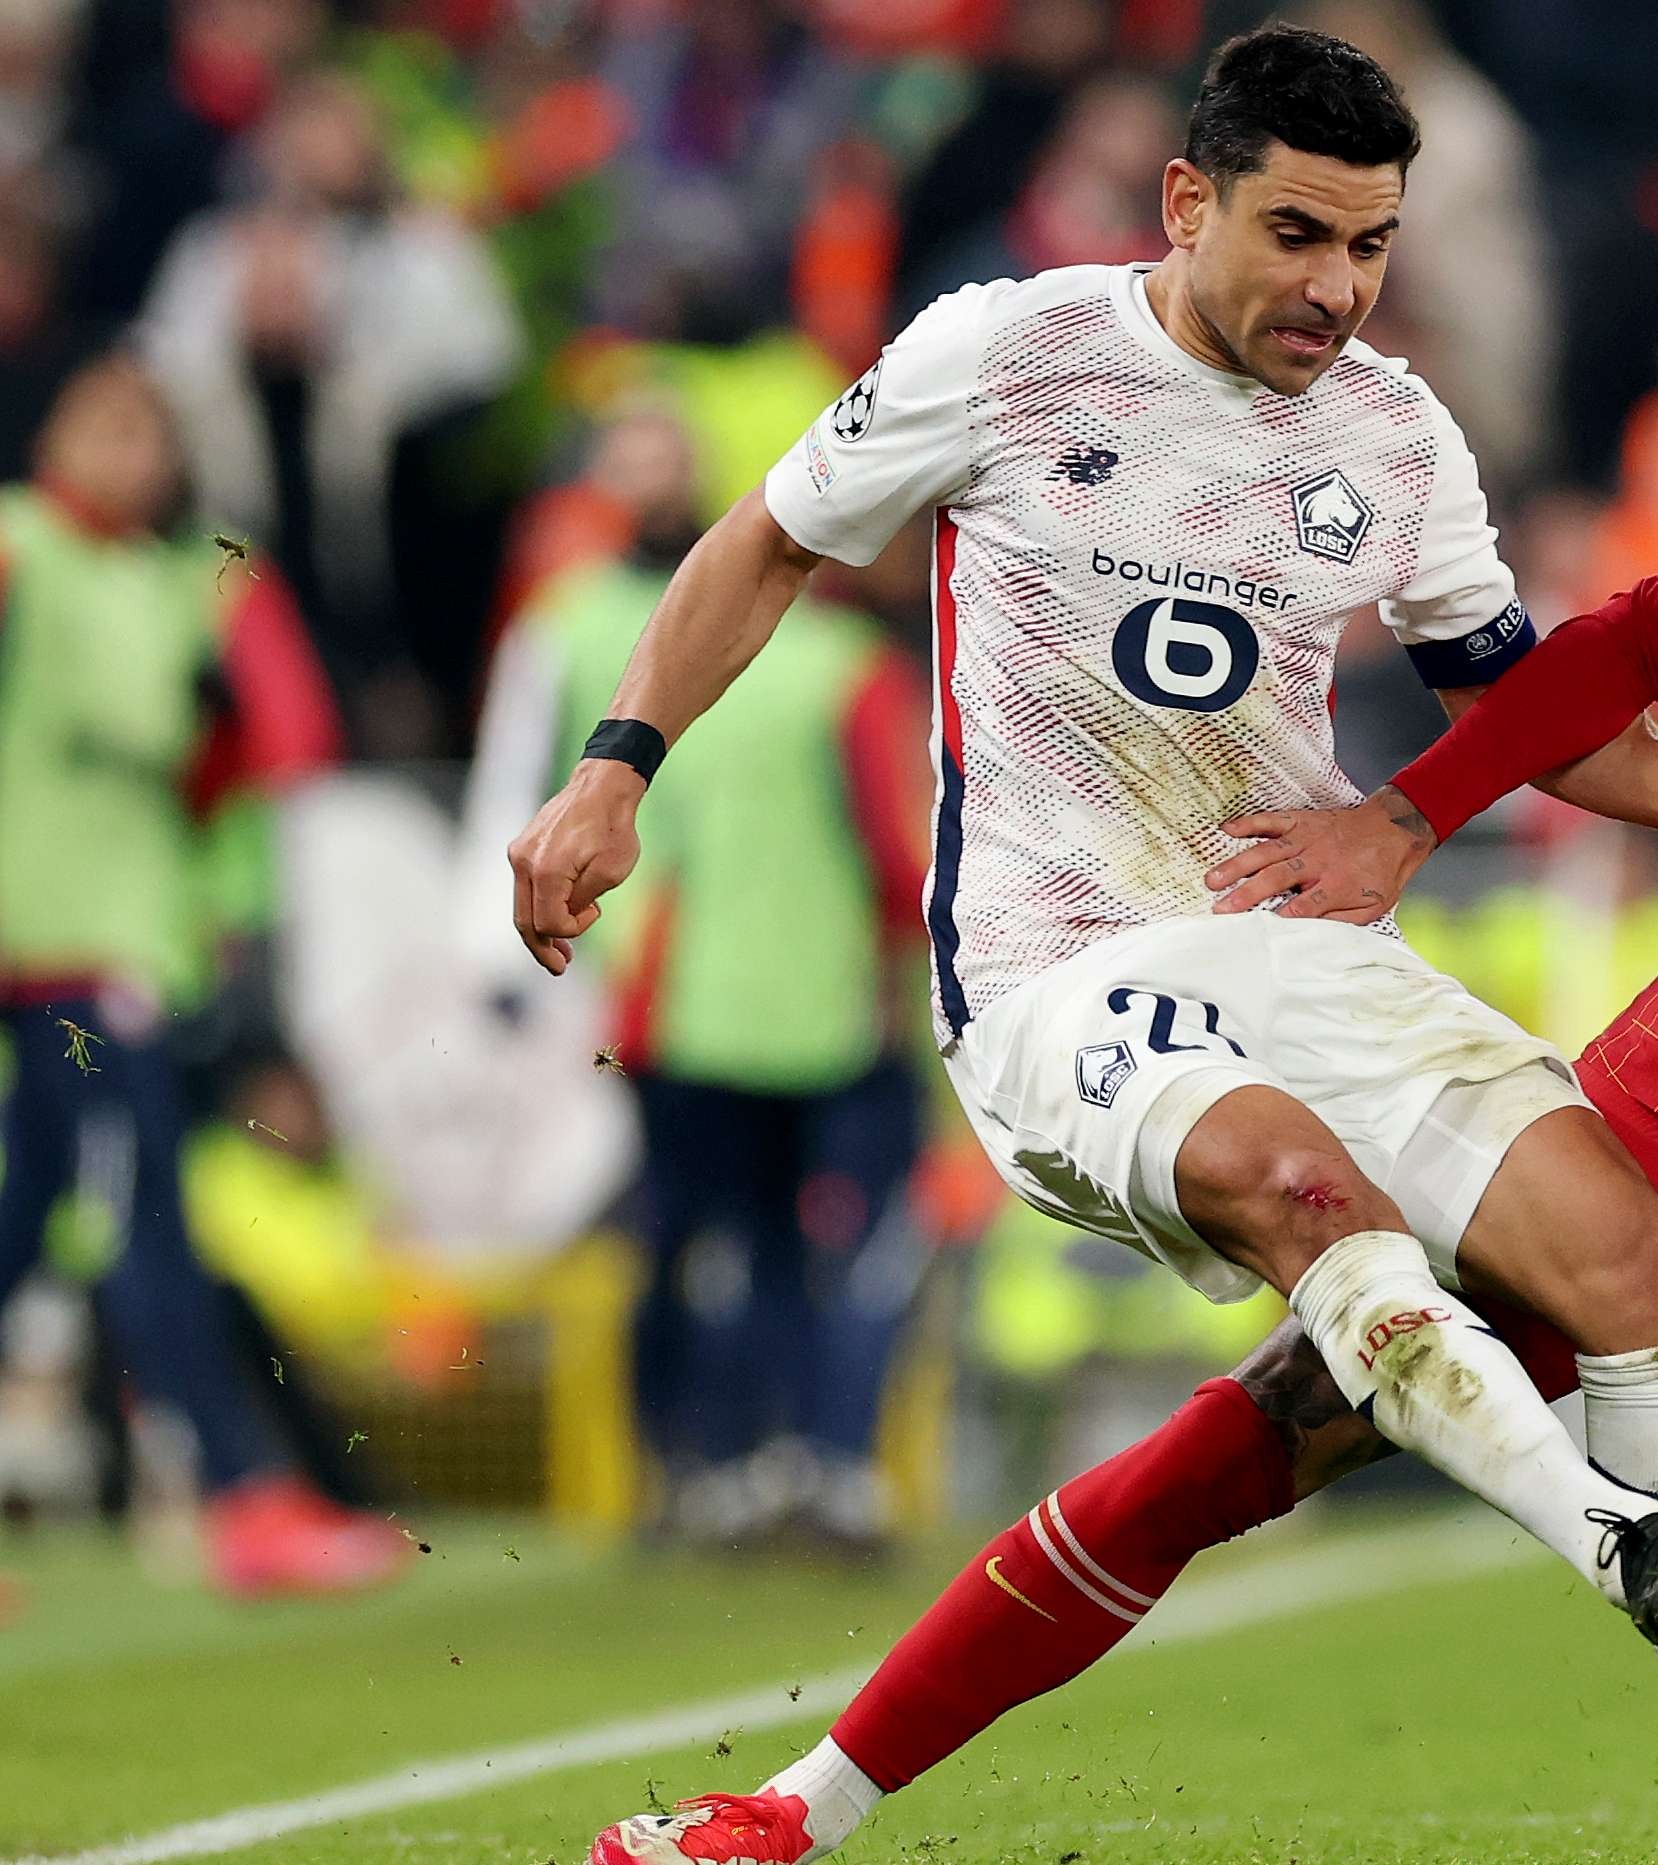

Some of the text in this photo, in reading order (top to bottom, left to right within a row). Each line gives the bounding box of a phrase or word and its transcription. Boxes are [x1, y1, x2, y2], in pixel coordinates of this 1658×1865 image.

[1307, 528, 1349, 554] LOSC
[1092, 547, 1298, 611] boulanger
[1496, 594, 1523, 638] RES
[1100, 1063, 1131, 1100] LOSC
[1357, 1307, 1453, 1372] LOSC
